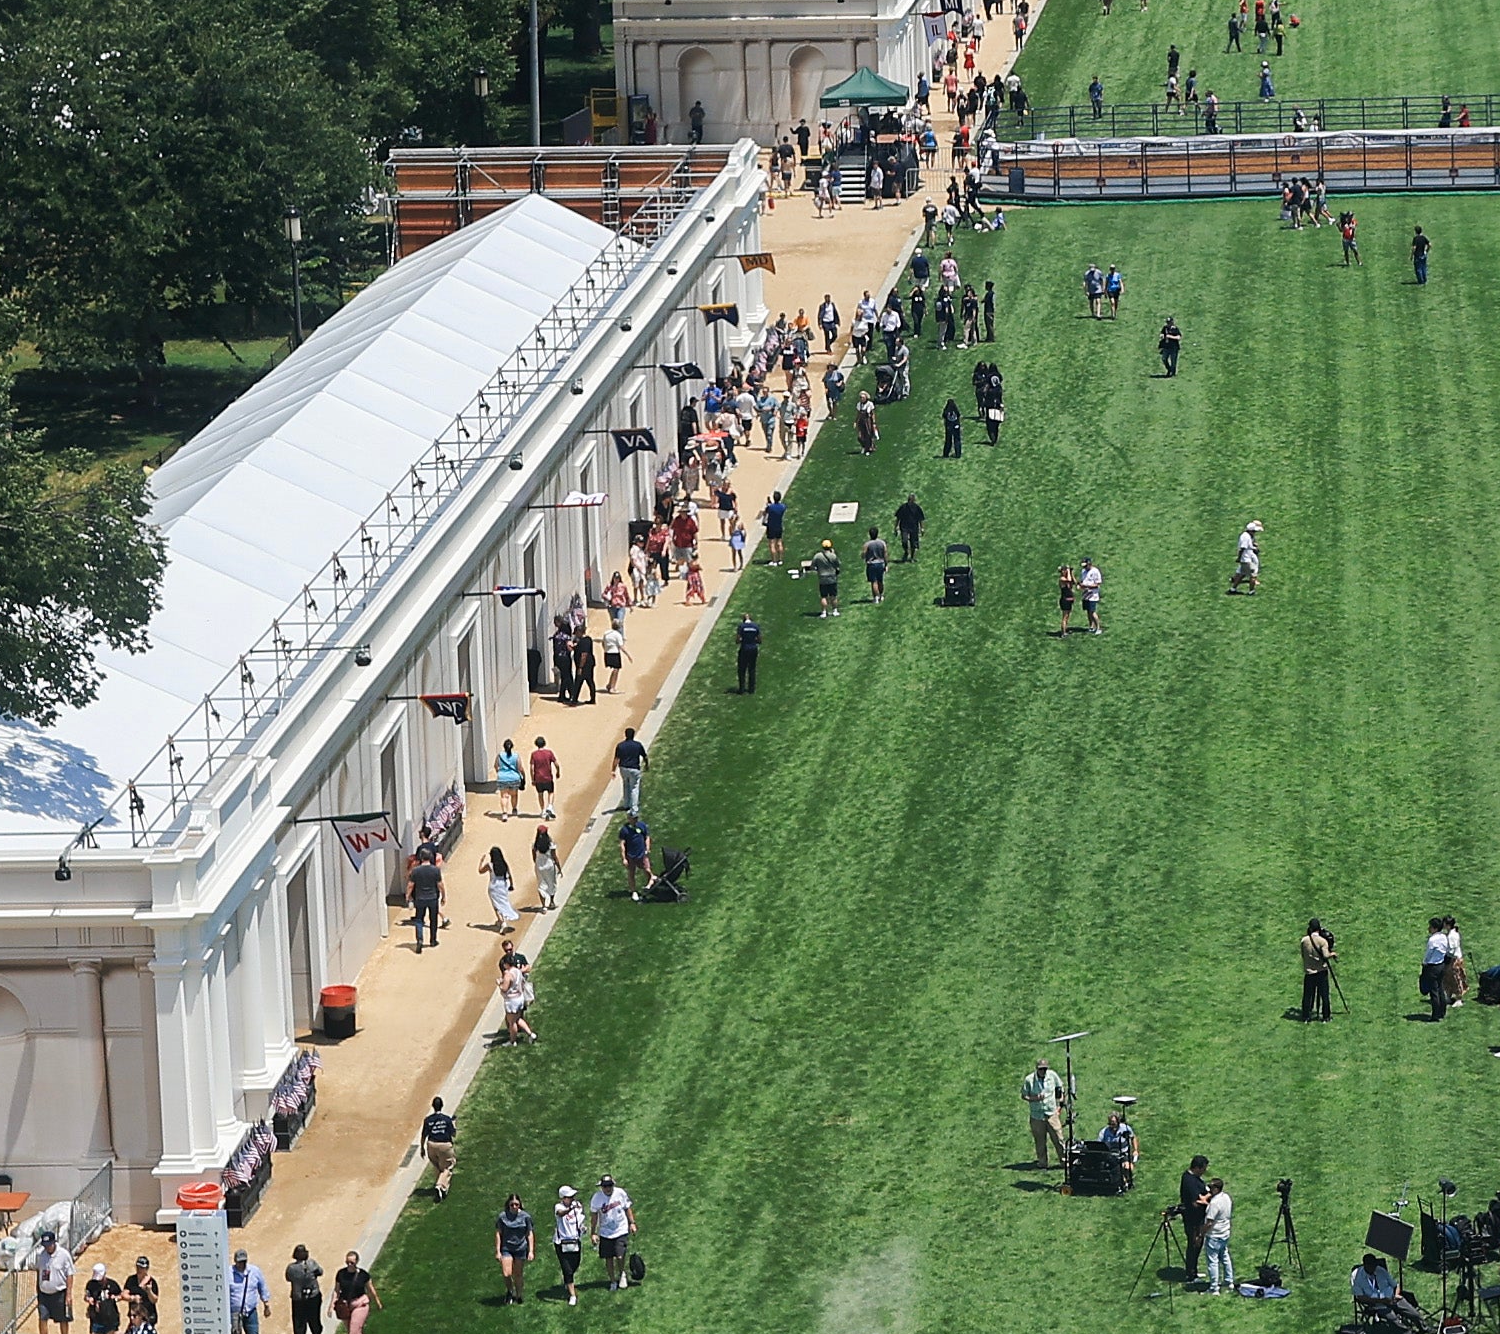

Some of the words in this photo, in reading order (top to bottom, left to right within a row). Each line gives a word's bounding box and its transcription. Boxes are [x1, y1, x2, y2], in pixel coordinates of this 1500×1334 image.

[930, 24, 942, 36] IL
[746, 255, 769, 266] MD
[669, 365, 696, 379] SC
[620, 434, 650, 448] VA
[345, 828, 388, 854] WV
